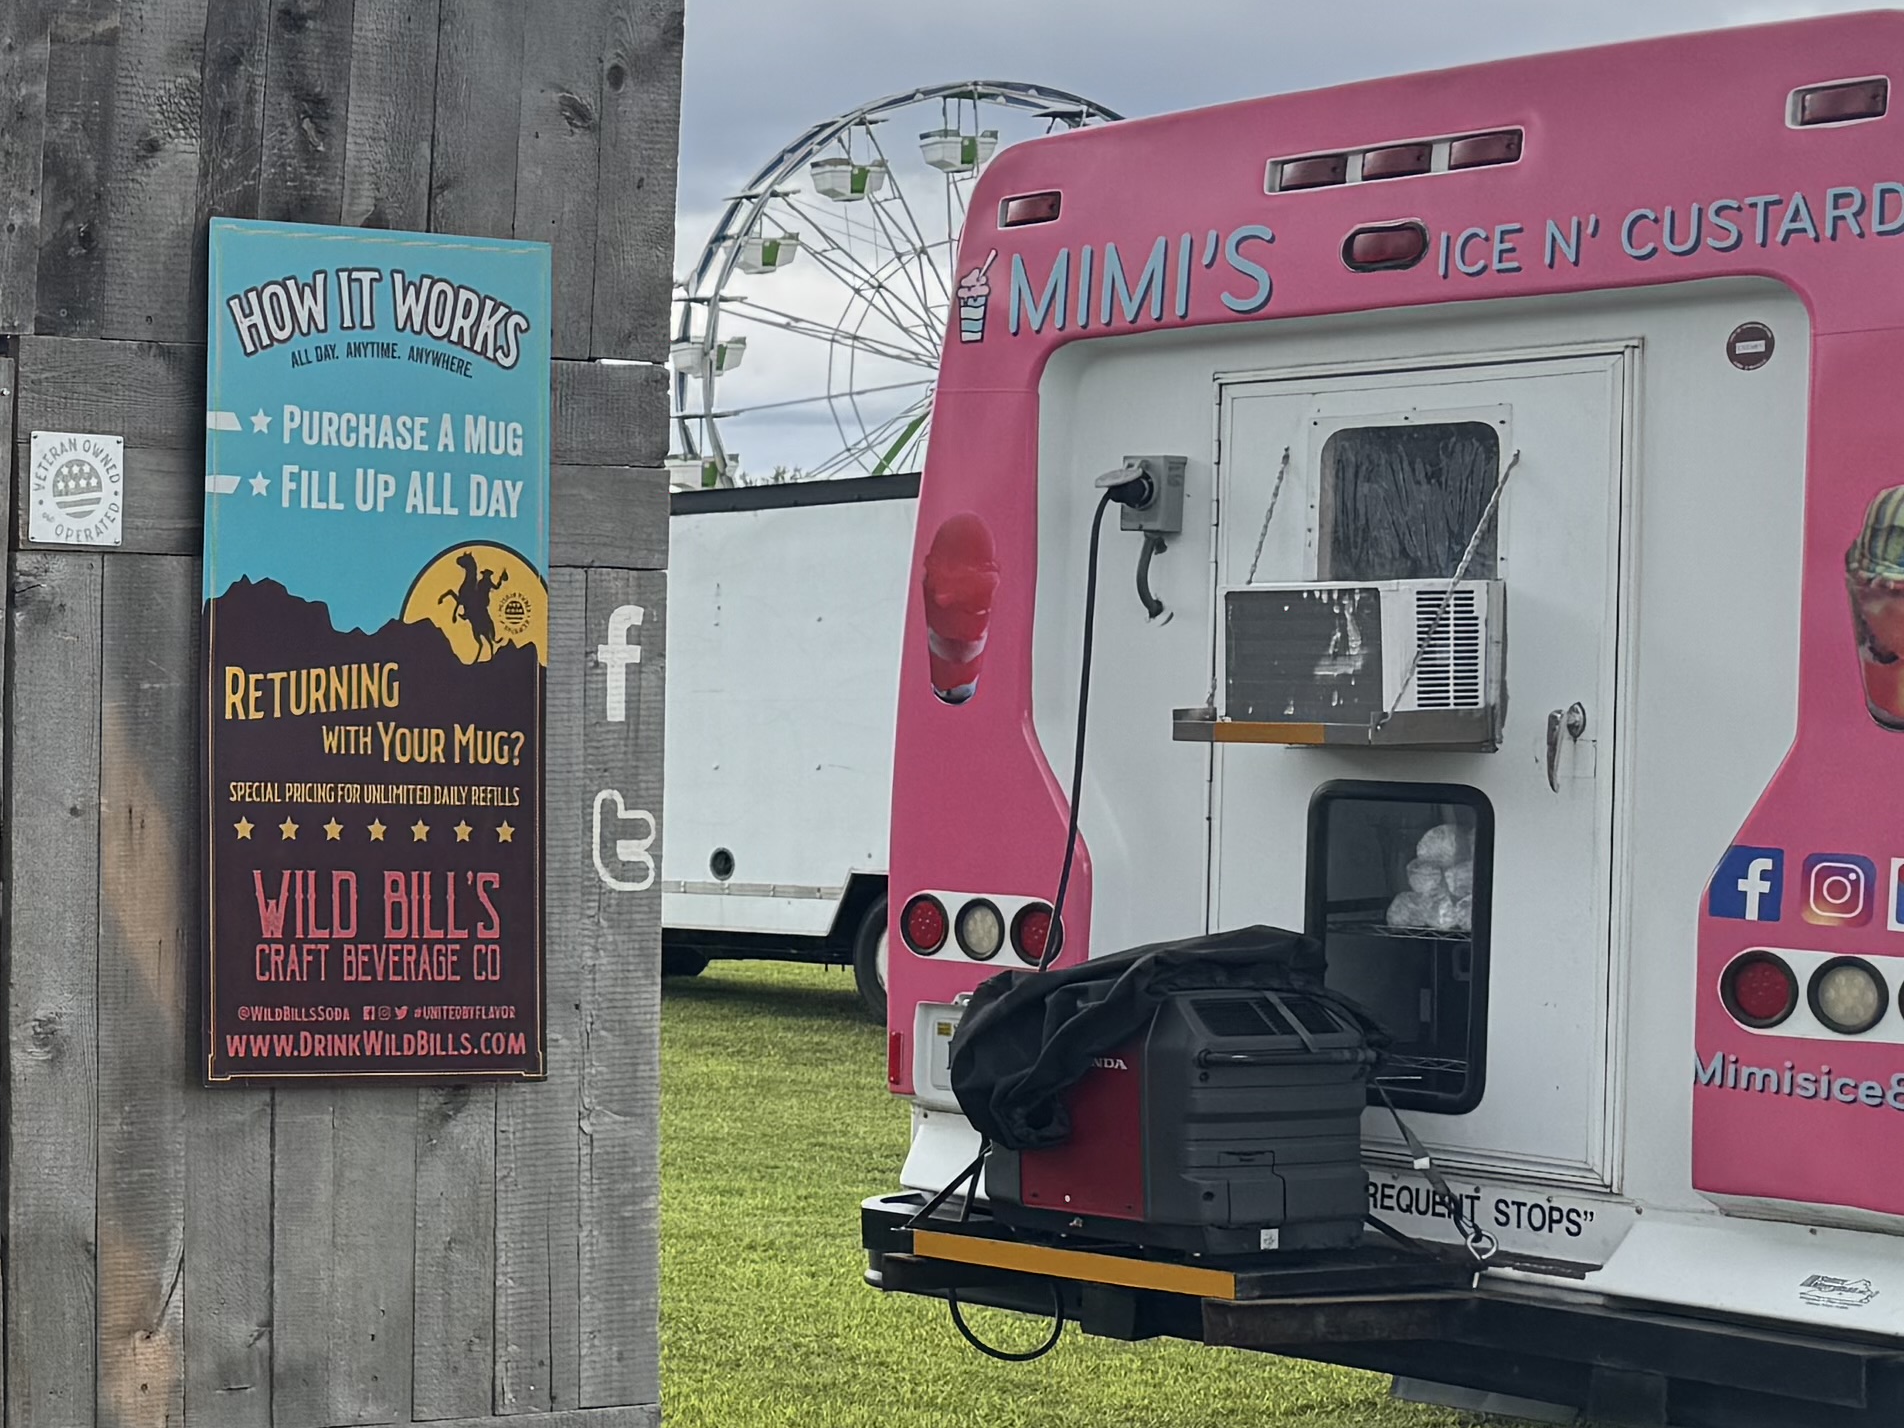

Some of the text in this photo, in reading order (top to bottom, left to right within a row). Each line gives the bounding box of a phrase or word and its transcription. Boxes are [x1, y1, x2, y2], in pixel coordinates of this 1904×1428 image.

[1008, 181, 1904, 336] MIMI'S ICE N' CUSTARD
[227, 267, 529, 370] HOW IT WORKS
[291, 341, 474, 379] ALL DAY. ANYTIME. ANYWHERE.
[283, 404, 523, 457] PURCHASE A MUG
[33, 438, 120, 492] VETERAN OWNED
[281, 464, 523, 519] FILL UP ALL DAY
[55, 502, 119, 542] OPERATED
[224, 662, 400, 720] RETURNING
[322, 721, 525, 766] WITH YOUR MUG?
[229, 782, 520, 807] SPECIAL PRICING FOR UNLIMITED DAILY REFILLS
[253, 870, 500, 939] WILD BILL'S
[255, 944, 500, 981] CRAFT BEVERAGE CO
[226, 1030, 526, 1058] WWW.DRINKWILDBILLS.COM
[1092, 1057, 1128, 1071] NDA
[1367, 1182, 1481, 1223] REQUENT
